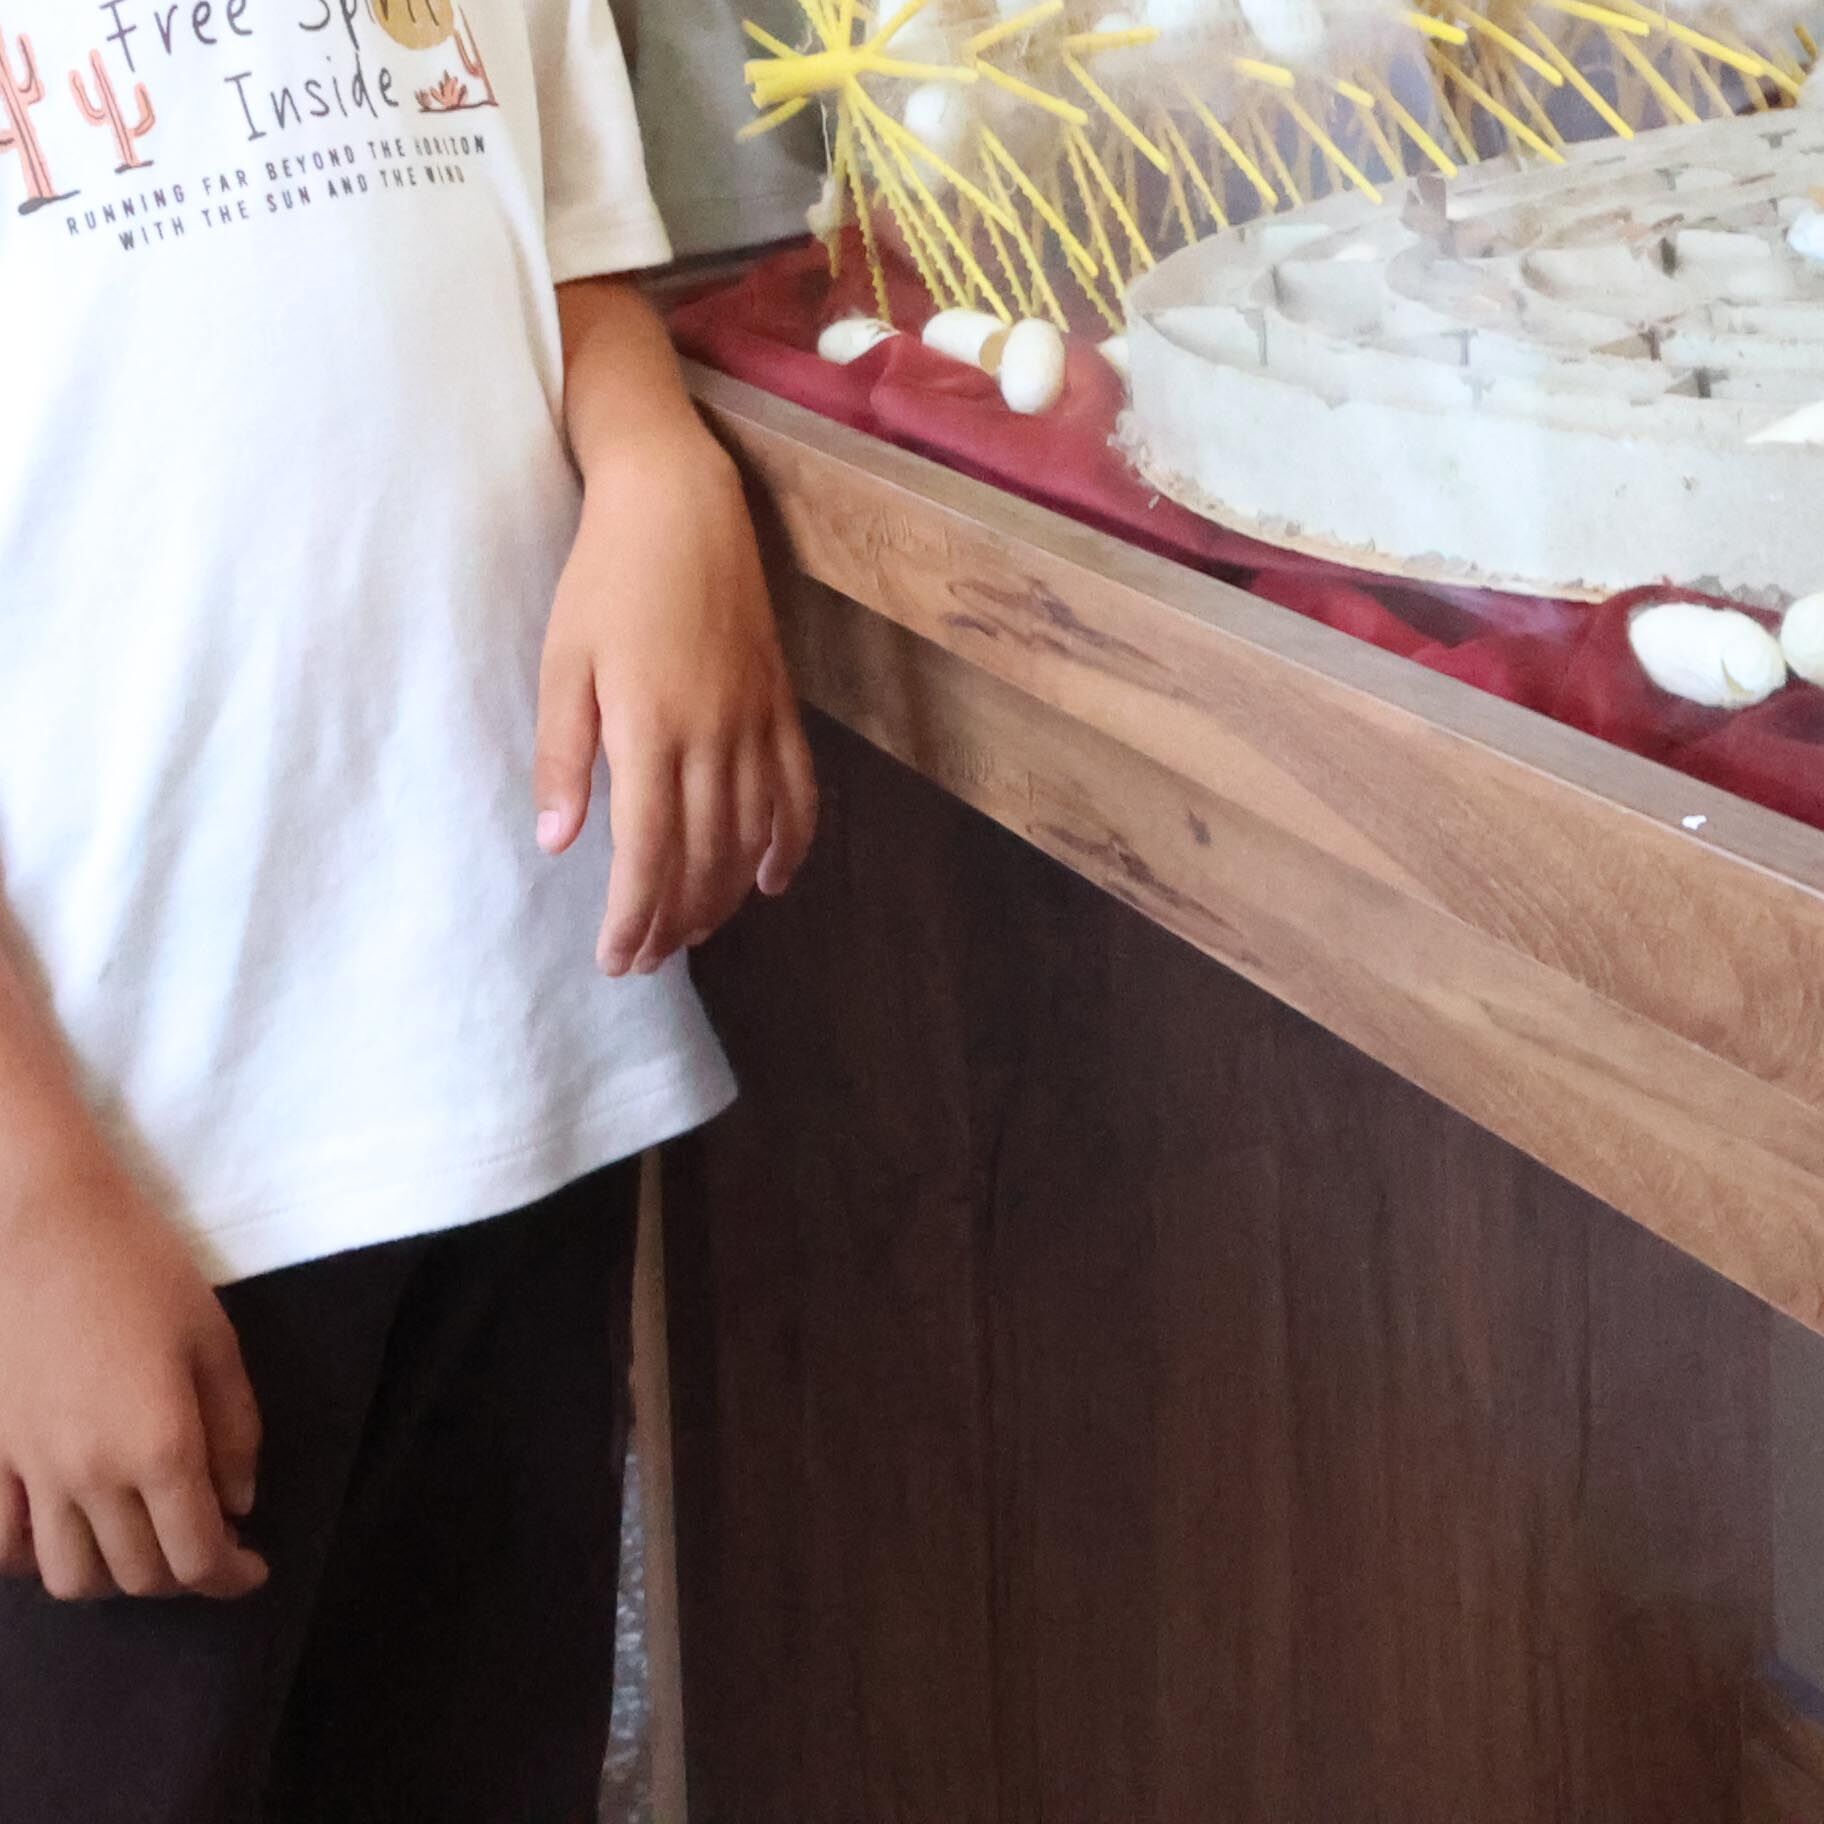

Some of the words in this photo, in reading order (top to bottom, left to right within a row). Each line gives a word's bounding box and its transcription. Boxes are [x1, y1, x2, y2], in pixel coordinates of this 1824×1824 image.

[224, 52, 399, 142] Inside
[66, 184, 185, 236] RUNNING
[202, 169, 248, 196] FAR
[265, 144, 355, 181] BEYOND
[367, 138, 406, 161] THE
[414, 134, 485, 157] HORIZON
[118, 216, 185, 252] WITH
[201, 200, 249, 228] THE
[266, 186, 311, 213] SUN
[328, 174, 368, 198] AND
[380, 167, 417, 189] THE
[425, 164, 464, 185] WIND
